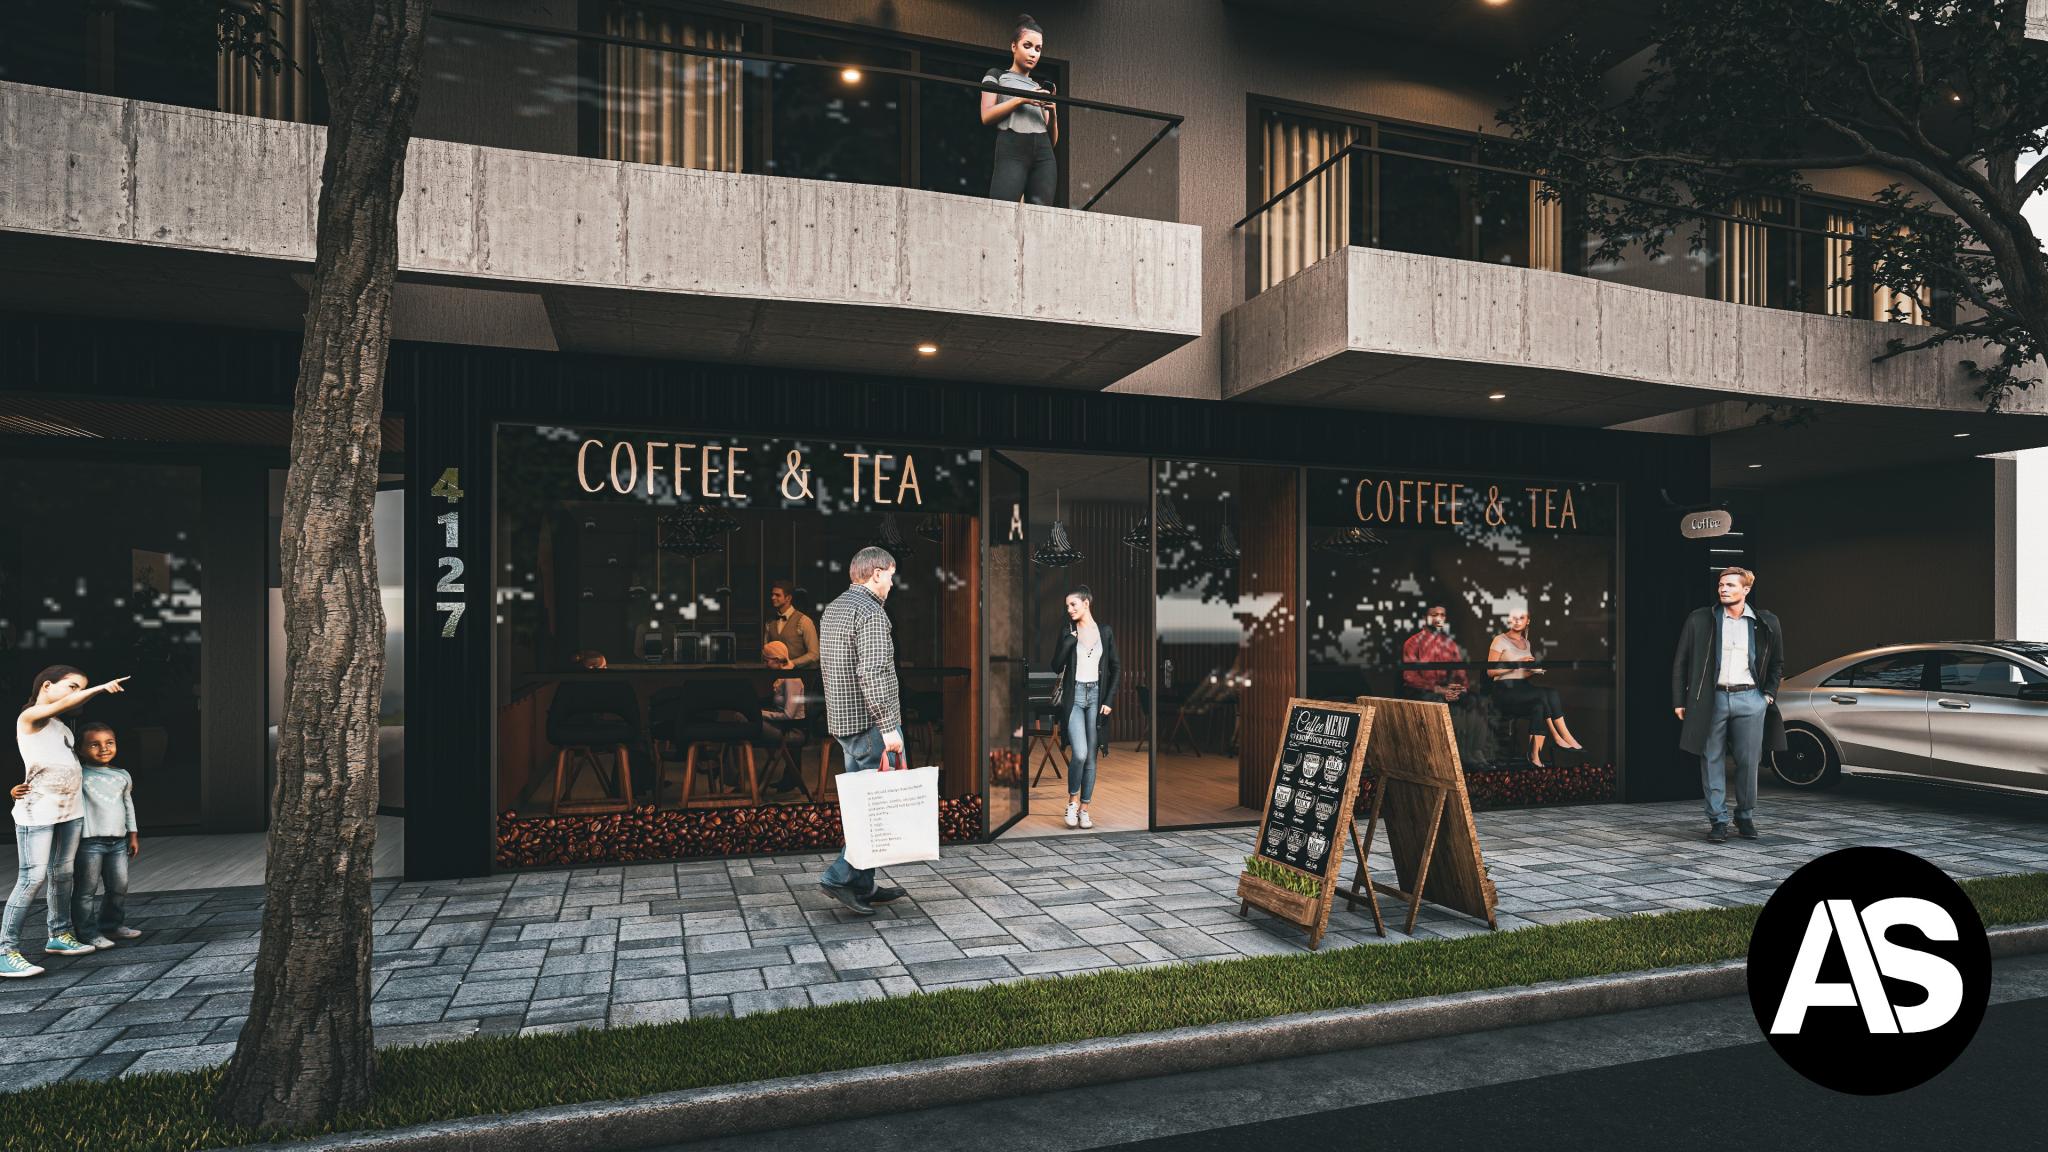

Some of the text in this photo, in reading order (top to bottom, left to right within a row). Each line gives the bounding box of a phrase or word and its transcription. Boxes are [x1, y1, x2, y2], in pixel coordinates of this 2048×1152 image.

[577, 439, 922, 505] COFFEE & TEA
[1355, 478, 1577, 529] COFFEE & TEA
[1691, 517, 1721, 530] Coffee
[431, 467, 466, 637] 4127
[1296, 710, 1350, 738] Coffee MENU
[1322, 737, 1342, 748] COFFEE
